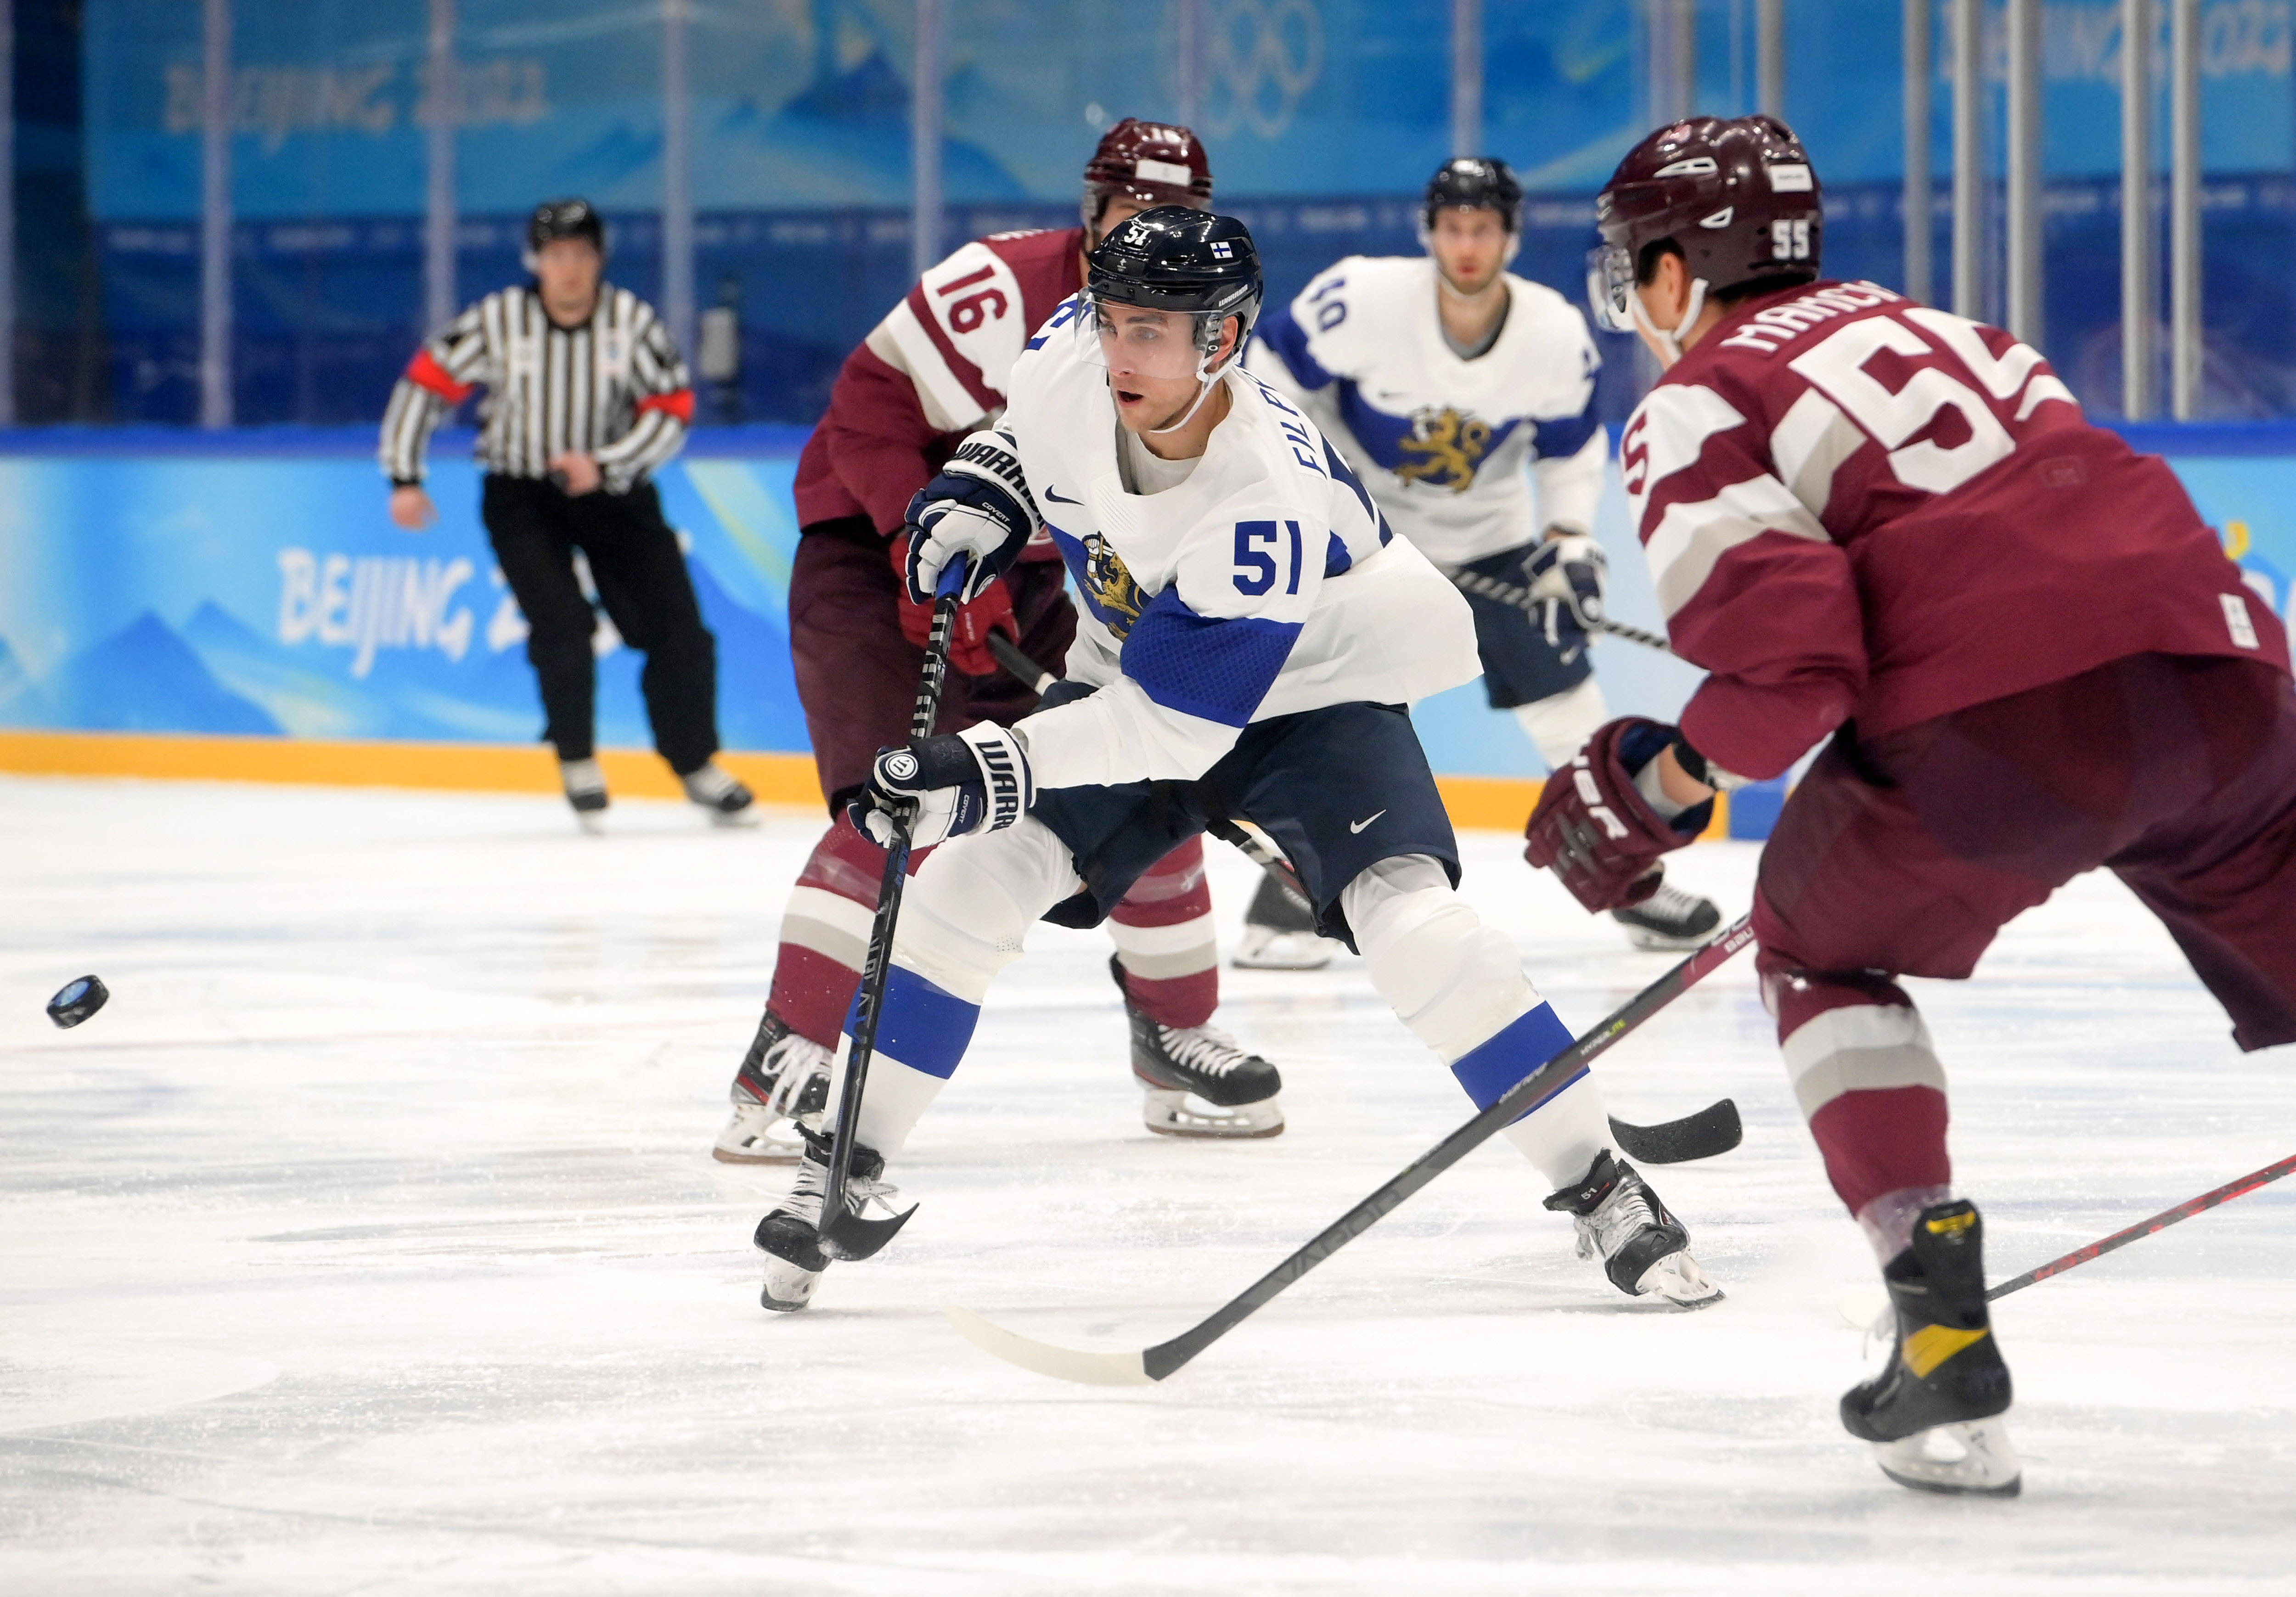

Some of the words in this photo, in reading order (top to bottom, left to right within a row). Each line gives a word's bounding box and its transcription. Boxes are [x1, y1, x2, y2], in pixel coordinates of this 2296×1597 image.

[1772, 219, 1810, 260] 55
[936, 263, 1008, 334] 16
[1788, 308, 2079, 495] 55
[982, 501, 1010, 523] COVERT
[1233, 520, 1302, 596] 51
[279, 547, 474, 677] BEIJING
[958, 793, 970, 824] COVERT
[1581, 1187, 1598, 1199] 51
